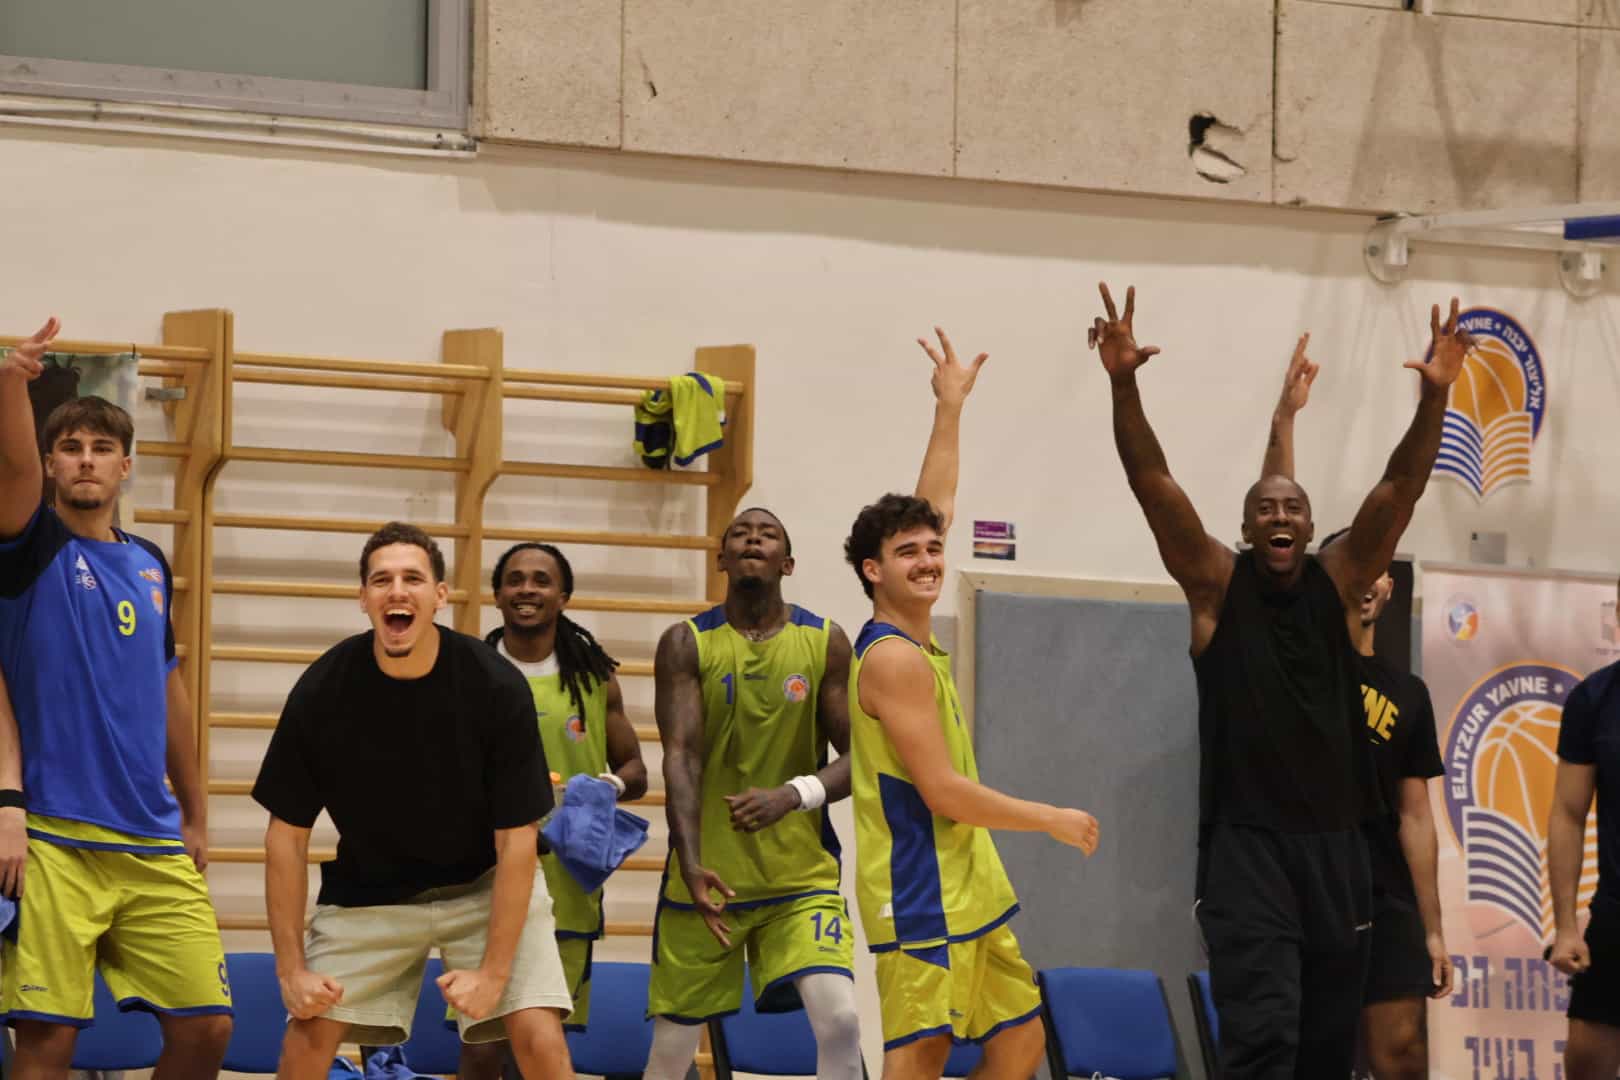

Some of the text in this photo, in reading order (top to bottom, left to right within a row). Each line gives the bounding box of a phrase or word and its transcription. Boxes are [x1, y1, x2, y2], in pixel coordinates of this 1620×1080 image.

[117, 600, 137, 637] 9
[1360, 683, 1400, 742] NE
[1451, 677, 1549, 800] ELITZUR YAVNE
[810, 911, 843, 945] 14
[1505, 958, 1568, 1010] פחה
